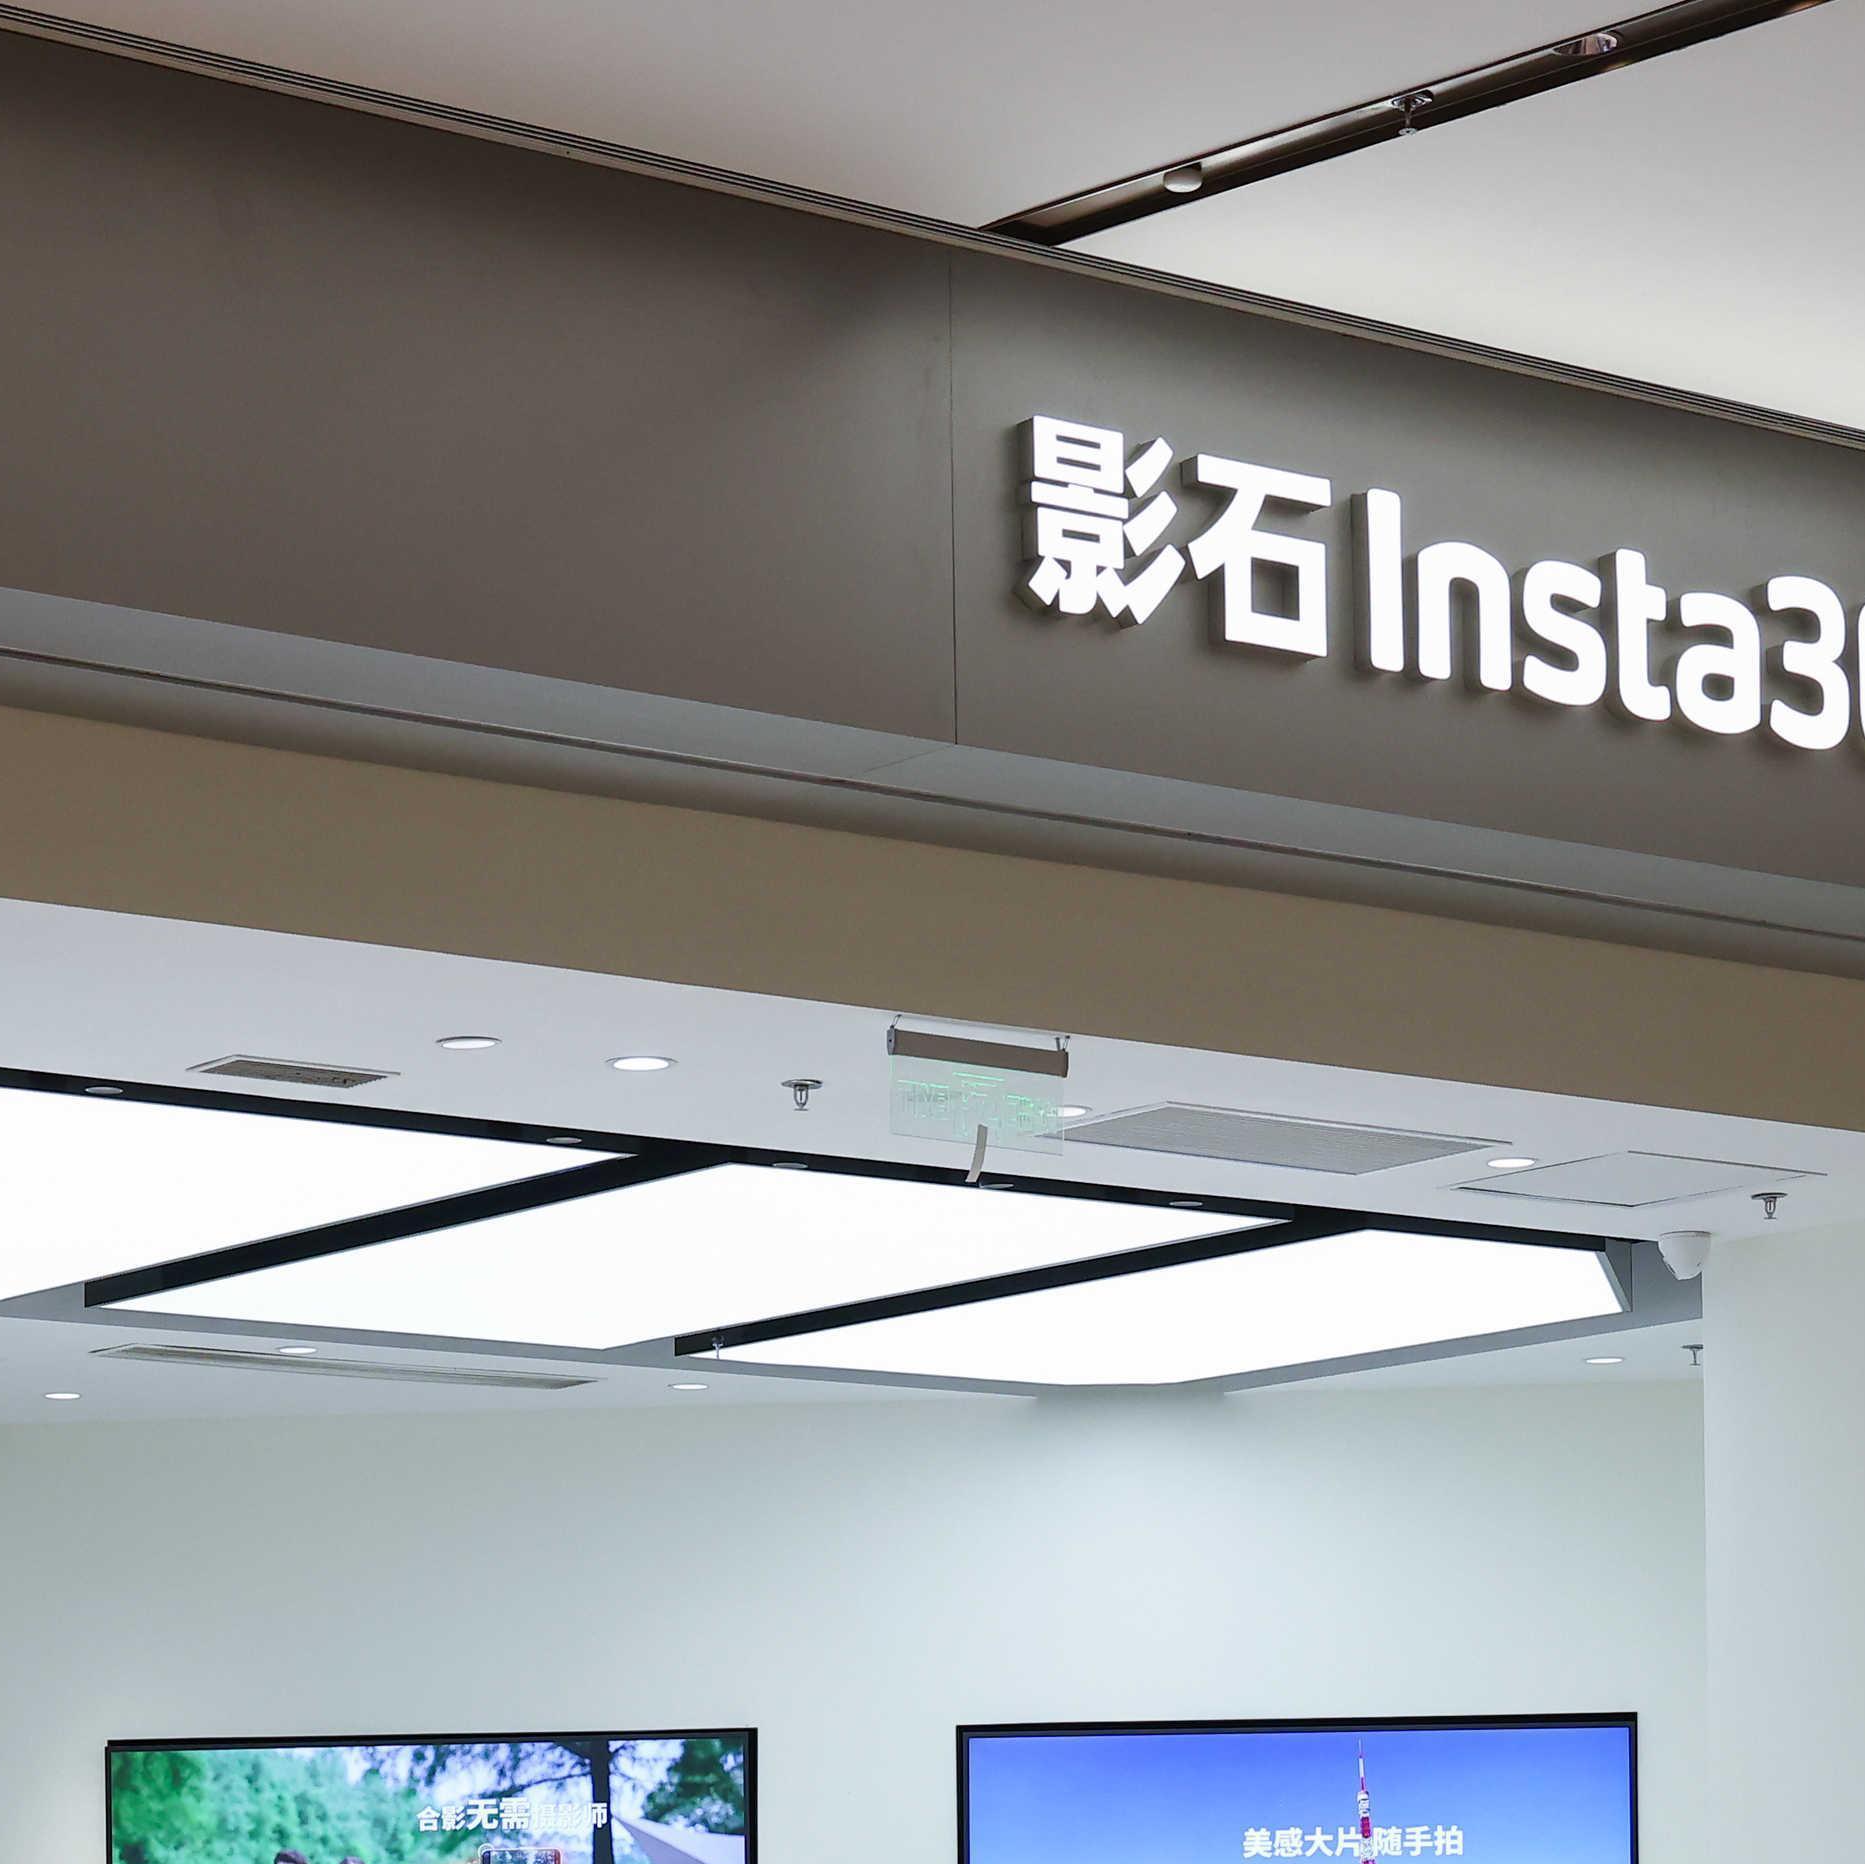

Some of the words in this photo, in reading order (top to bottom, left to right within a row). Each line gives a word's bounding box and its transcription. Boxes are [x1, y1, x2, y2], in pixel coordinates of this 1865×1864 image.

[1022, 415, 1332, 658] 影石
[1243, 1826, 1358, 1858] 美感大片
[1370, 1825, 1464, 1856] 随手拍
